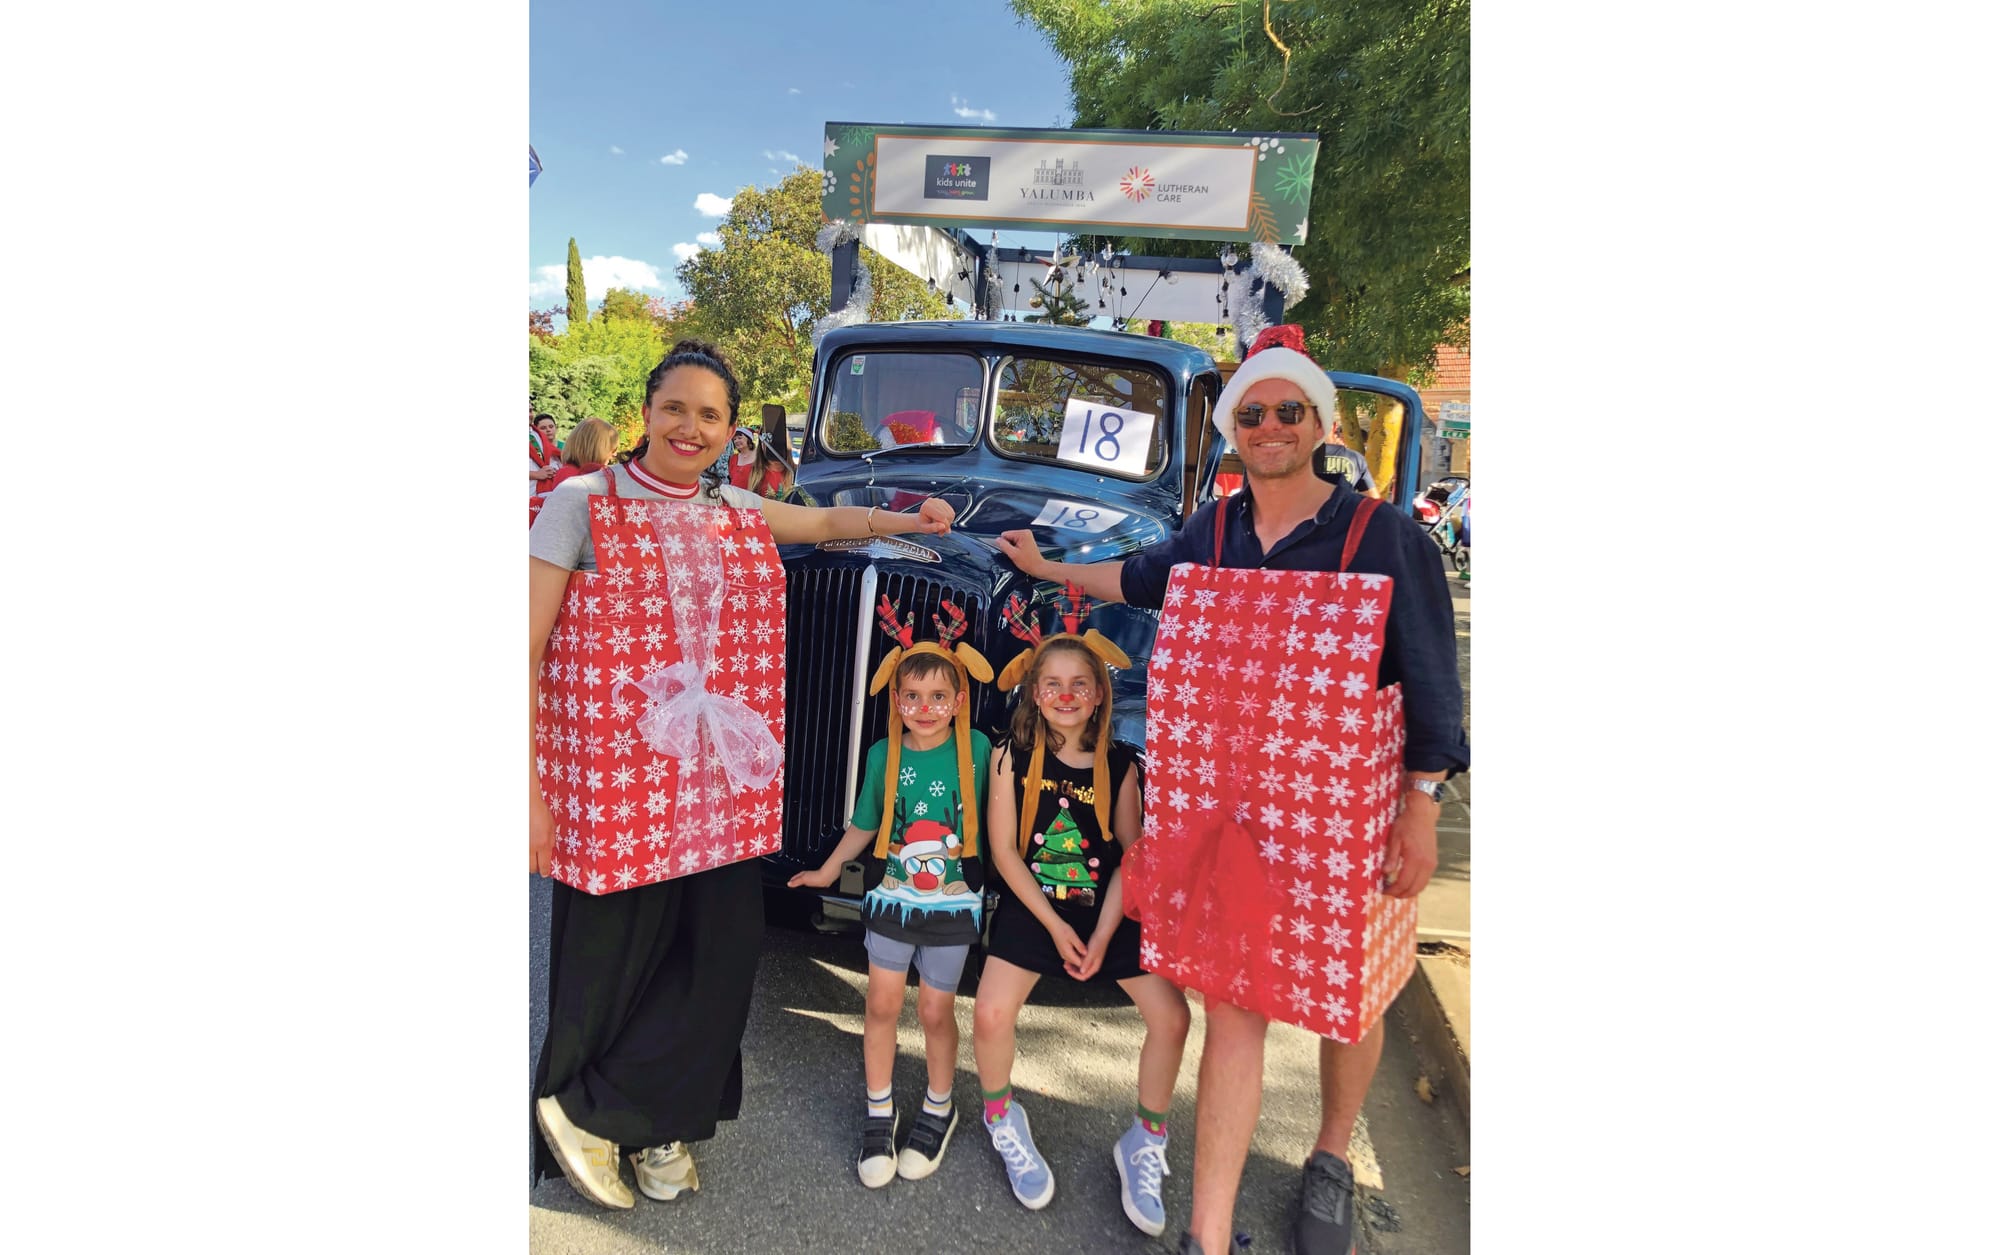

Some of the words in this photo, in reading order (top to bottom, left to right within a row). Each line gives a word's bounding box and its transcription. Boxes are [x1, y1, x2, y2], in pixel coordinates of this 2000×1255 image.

[936, 177, 953, 187] kids
[955, 178, 976, 188] unite
[1158, 183, 1209, 194] LUTHERAN
[1020, 187, 1095, 201] YALUMBA
[1156, 193, 1182, 203] CARE
[1079, 409, 1124, 461] 18
[1050, 506, 1100, 528] 18
